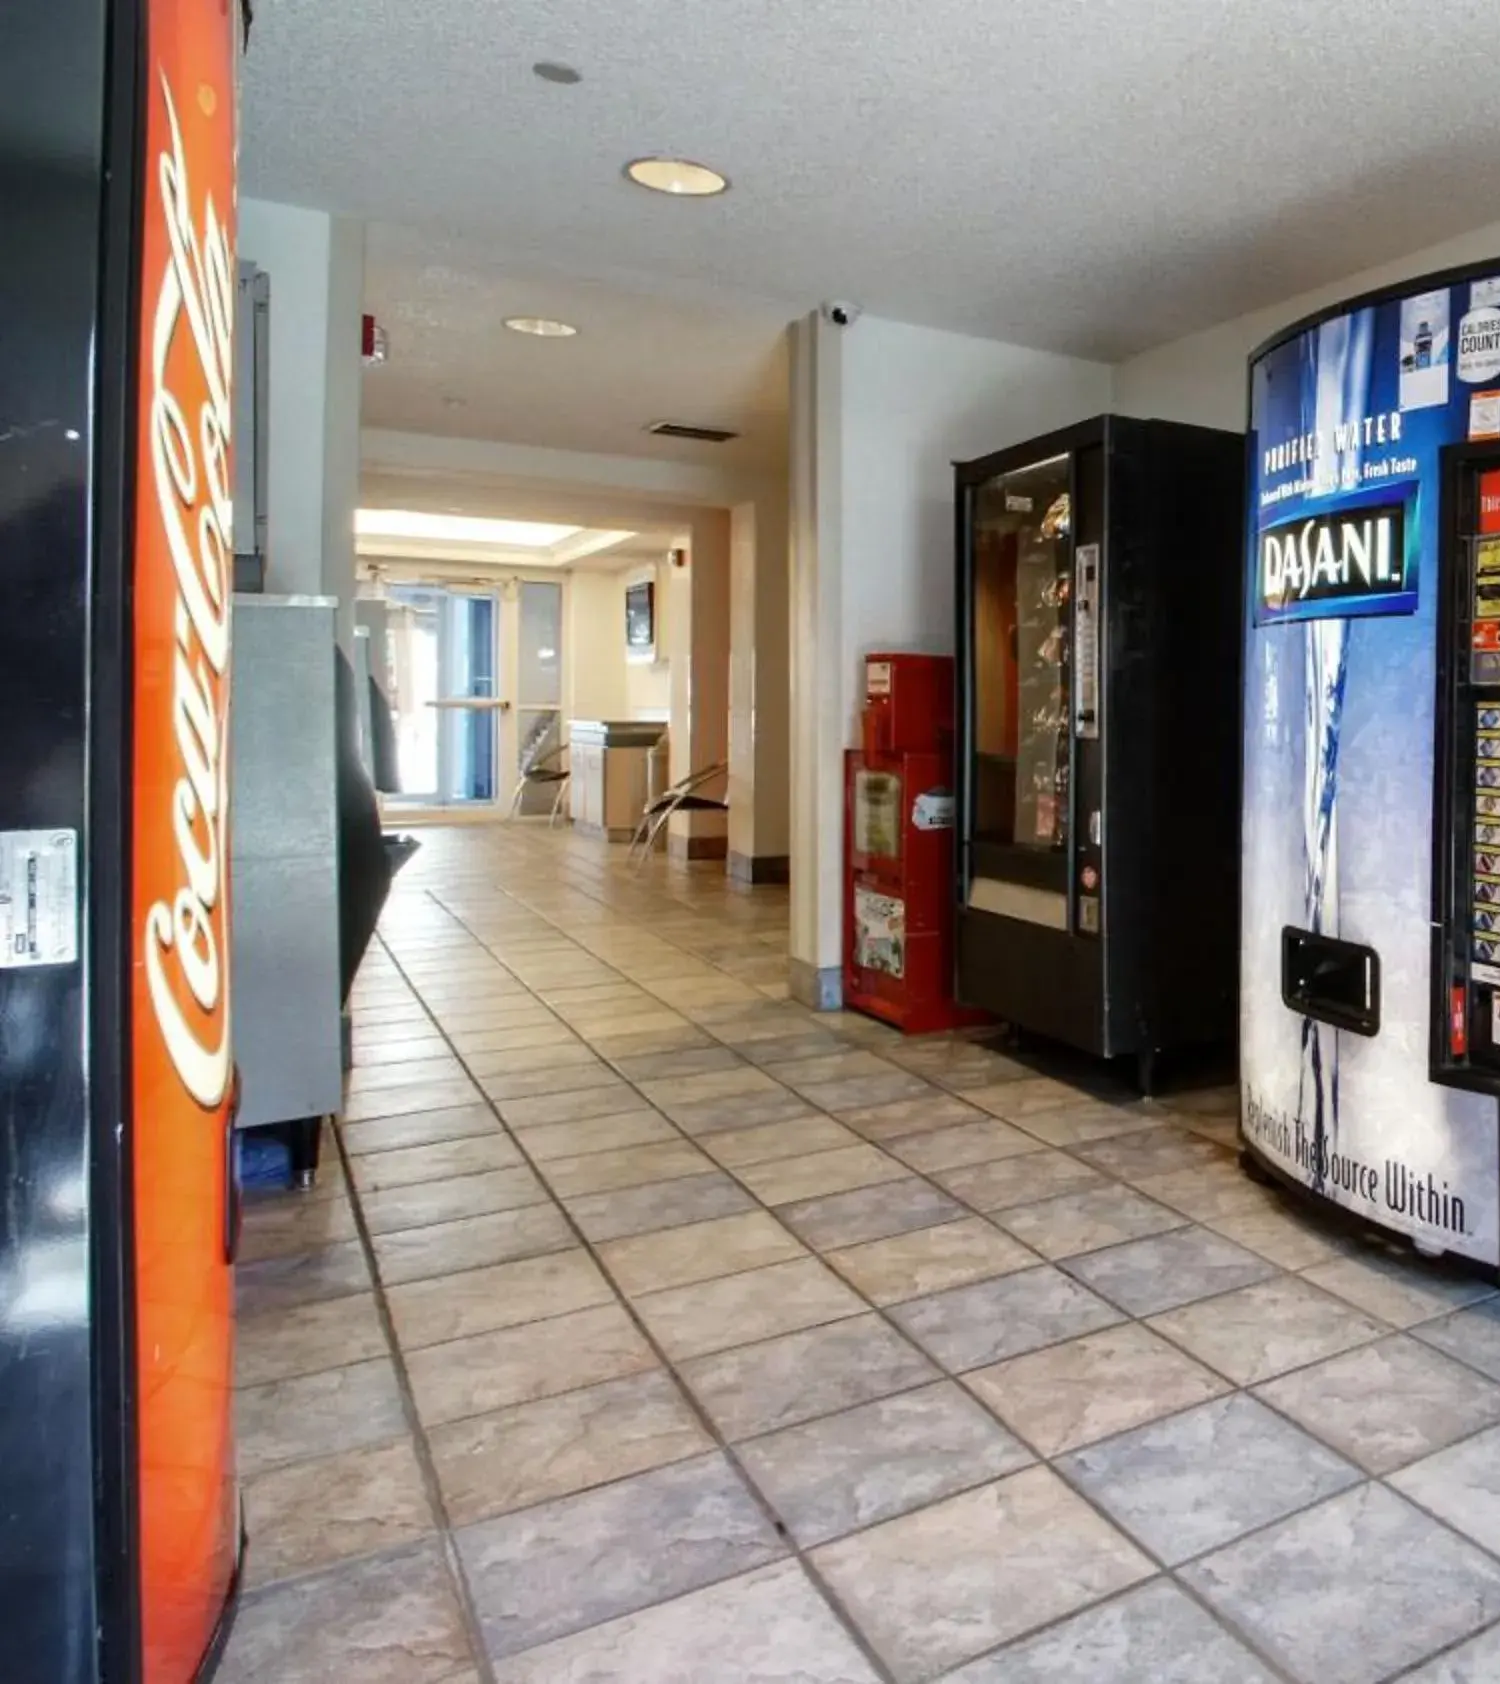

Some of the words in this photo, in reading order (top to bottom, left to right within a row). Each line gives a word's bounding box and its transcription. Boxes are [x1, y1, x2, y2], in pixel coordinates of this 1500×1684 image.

[1334, 411, 1401, 452] WATER
[1390, 457, 1417, 475] Taste
[1263, 517, 1392, 611] DASANI
[1293, 1117, 1319, 1174] The
[1318, 1134, 1378, 1203] Source
[1385, 1159, 1466, 1236] Within
